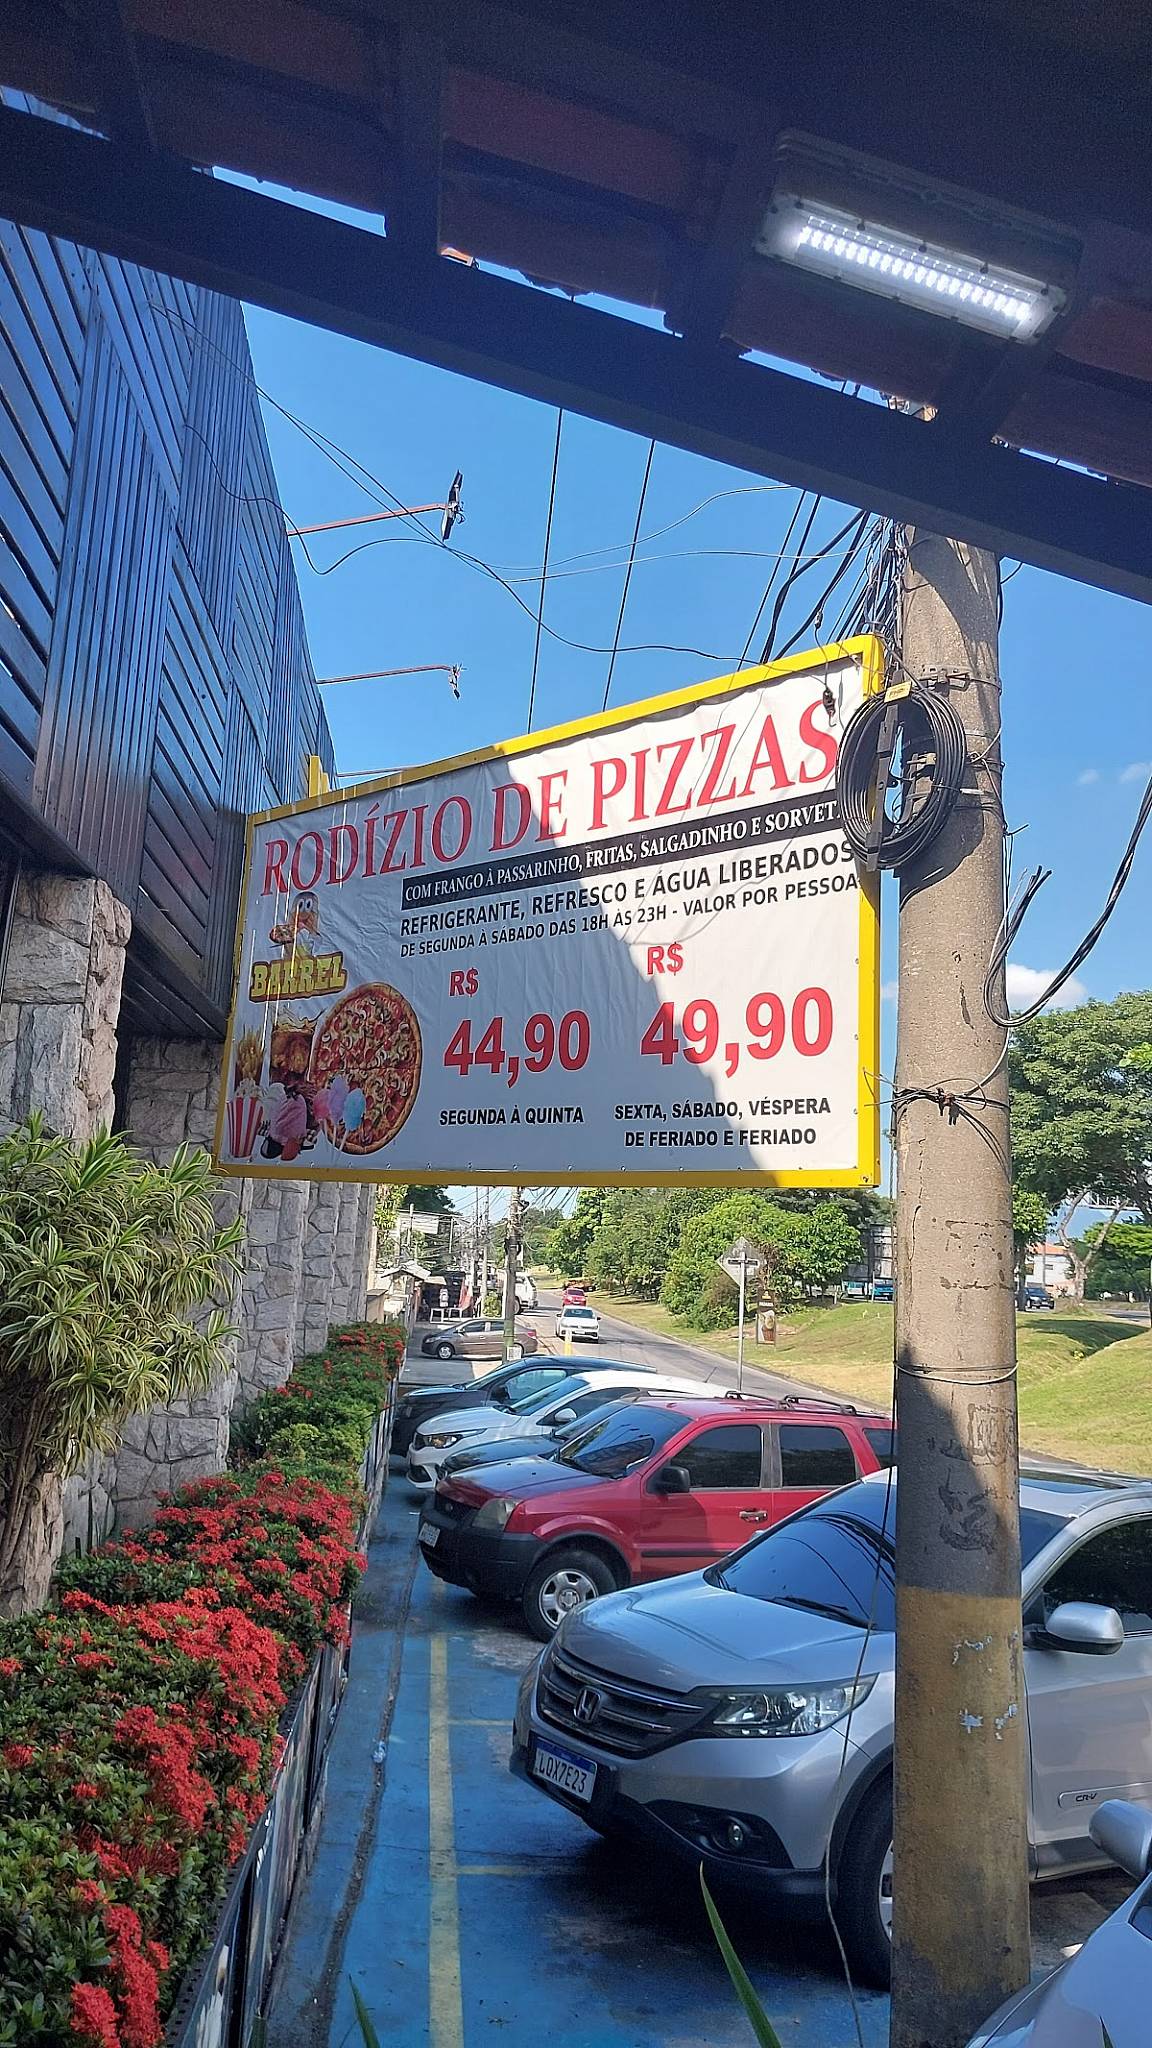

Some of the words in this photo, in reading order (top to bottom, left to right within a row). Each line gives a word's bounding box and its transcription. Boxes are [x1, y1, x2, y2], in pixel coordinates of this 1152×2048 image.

[260, 795, 472, 897] RODÍZIO
[488, 768, 569, 852] DE
[586, 698, 839, 832] PIZZAS
[405, 881, 432, 902] COM
[434, 871, 484, 896] FRANGO
[486, 867, 494, 888] À
[497, 853, 583, 884] PASSARINHO,
[585, 841, 638, 867] FRITAS,
[640, 819, 747, 858] SALGADINHO
[751, 816, 763, 835] E
[764, 799, 841, 833] SORVET
[401, 899, 526, 937] REFRIGERANTE,
[532, 881, 627, 917] REFRESCO
[634, 879, 646, 899] E
[652, 869, 711, 897] ÁGUA
[718, 839, 856, 884] LIBERADOS
[400, 944, 416, 958] DE
[418, 932, 475, 955] SEGUNDA
[478, 929, 488, 947] À
[491, 921, 545, 946] SÁBADO
[549, 918, 577, 937] DAS
[581, 913, 609, 933] 18H
[612, 906, 633, 927] ÀS
[637, 909, 667, 925] 23H
[683, 897, 736, 919] VALOR
[742, 886, 779, 908] POR
[784, 872, 858, 900] PESSOA
[250, 954, 346, 1000] BARREL
[449, 967, 480, 997] R$
[648, 942, 685, 976] R$
[443, 1010, 592, 1089] 44,90
[640, 987, 834, 1079] 49,90
[439, 1107, 507, 1126] SEGUNDA
[511, 1104, 522, 1125] À
[524, 1106, 585, 1124] QUINTA
[614, 1103, 668, 1121] SEXTA,
[671, 1099, 744, 1121] SÁBADO,
[749, 1096, 832, 1116] VÉSPERA
[624, 1131, 645, 1147] DE
[648, 1130, 719, 1147] FERIADO
[723, 1131, 734, 1145] E
[738, 1127, 818, 1146] FERIADO
[1075, 1792, 1098, 1802] CR-V
